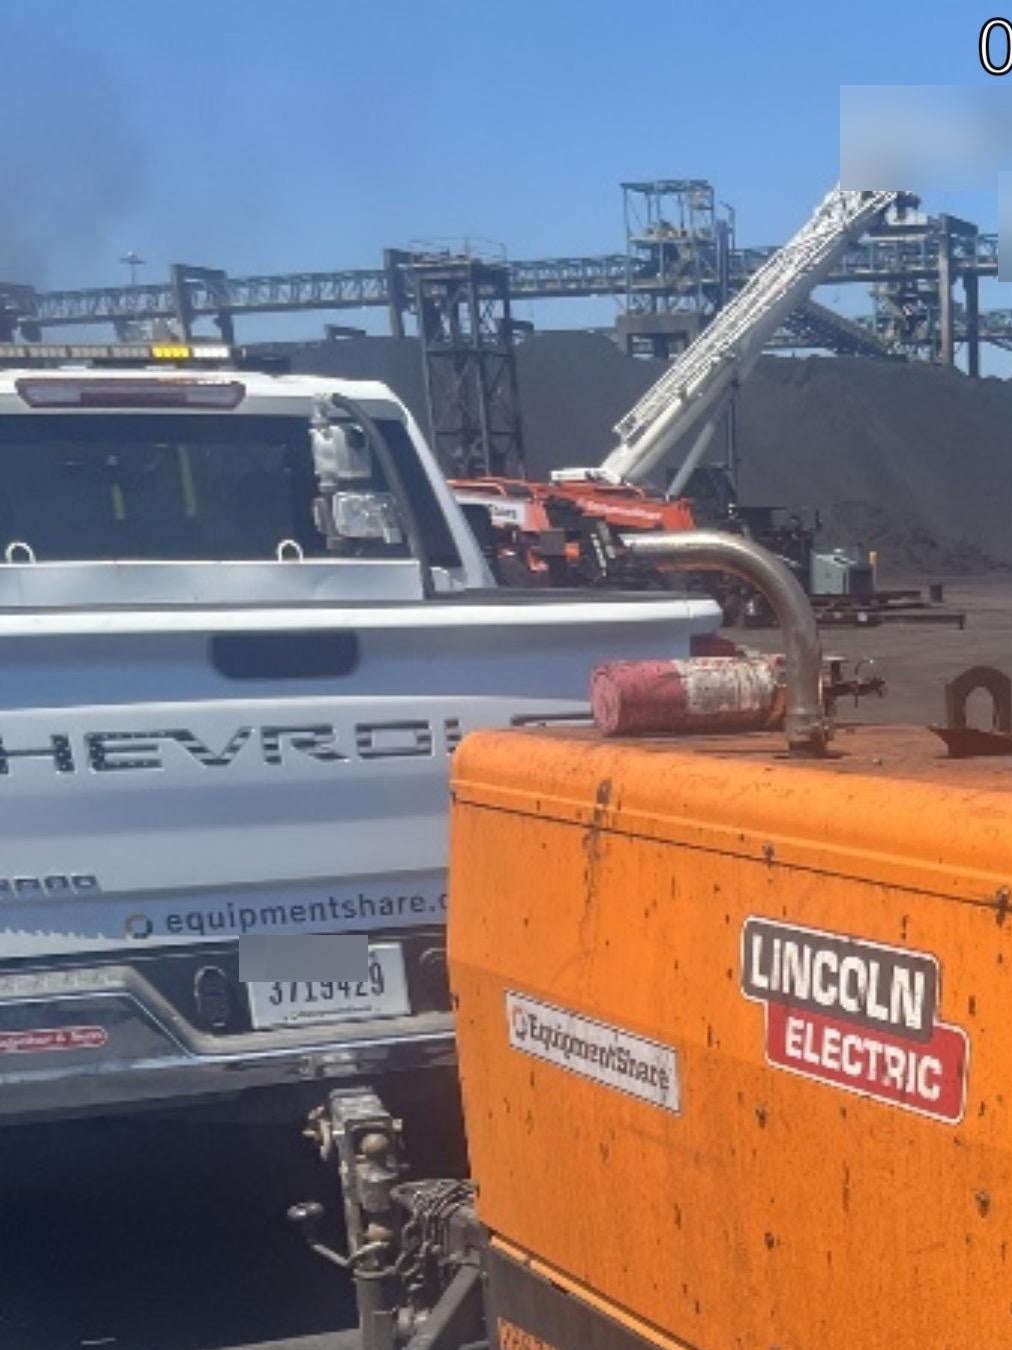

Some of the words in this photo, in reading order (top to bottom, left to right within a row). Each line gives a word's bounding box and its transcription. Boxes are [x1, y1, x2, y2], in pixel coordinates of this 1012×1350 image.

[750, 933, 925, 1030] LINCOLN
[527, 1012, 671, 1093] EquipmentShare
[784, 1017, 943, 1101] ELECTRIC
